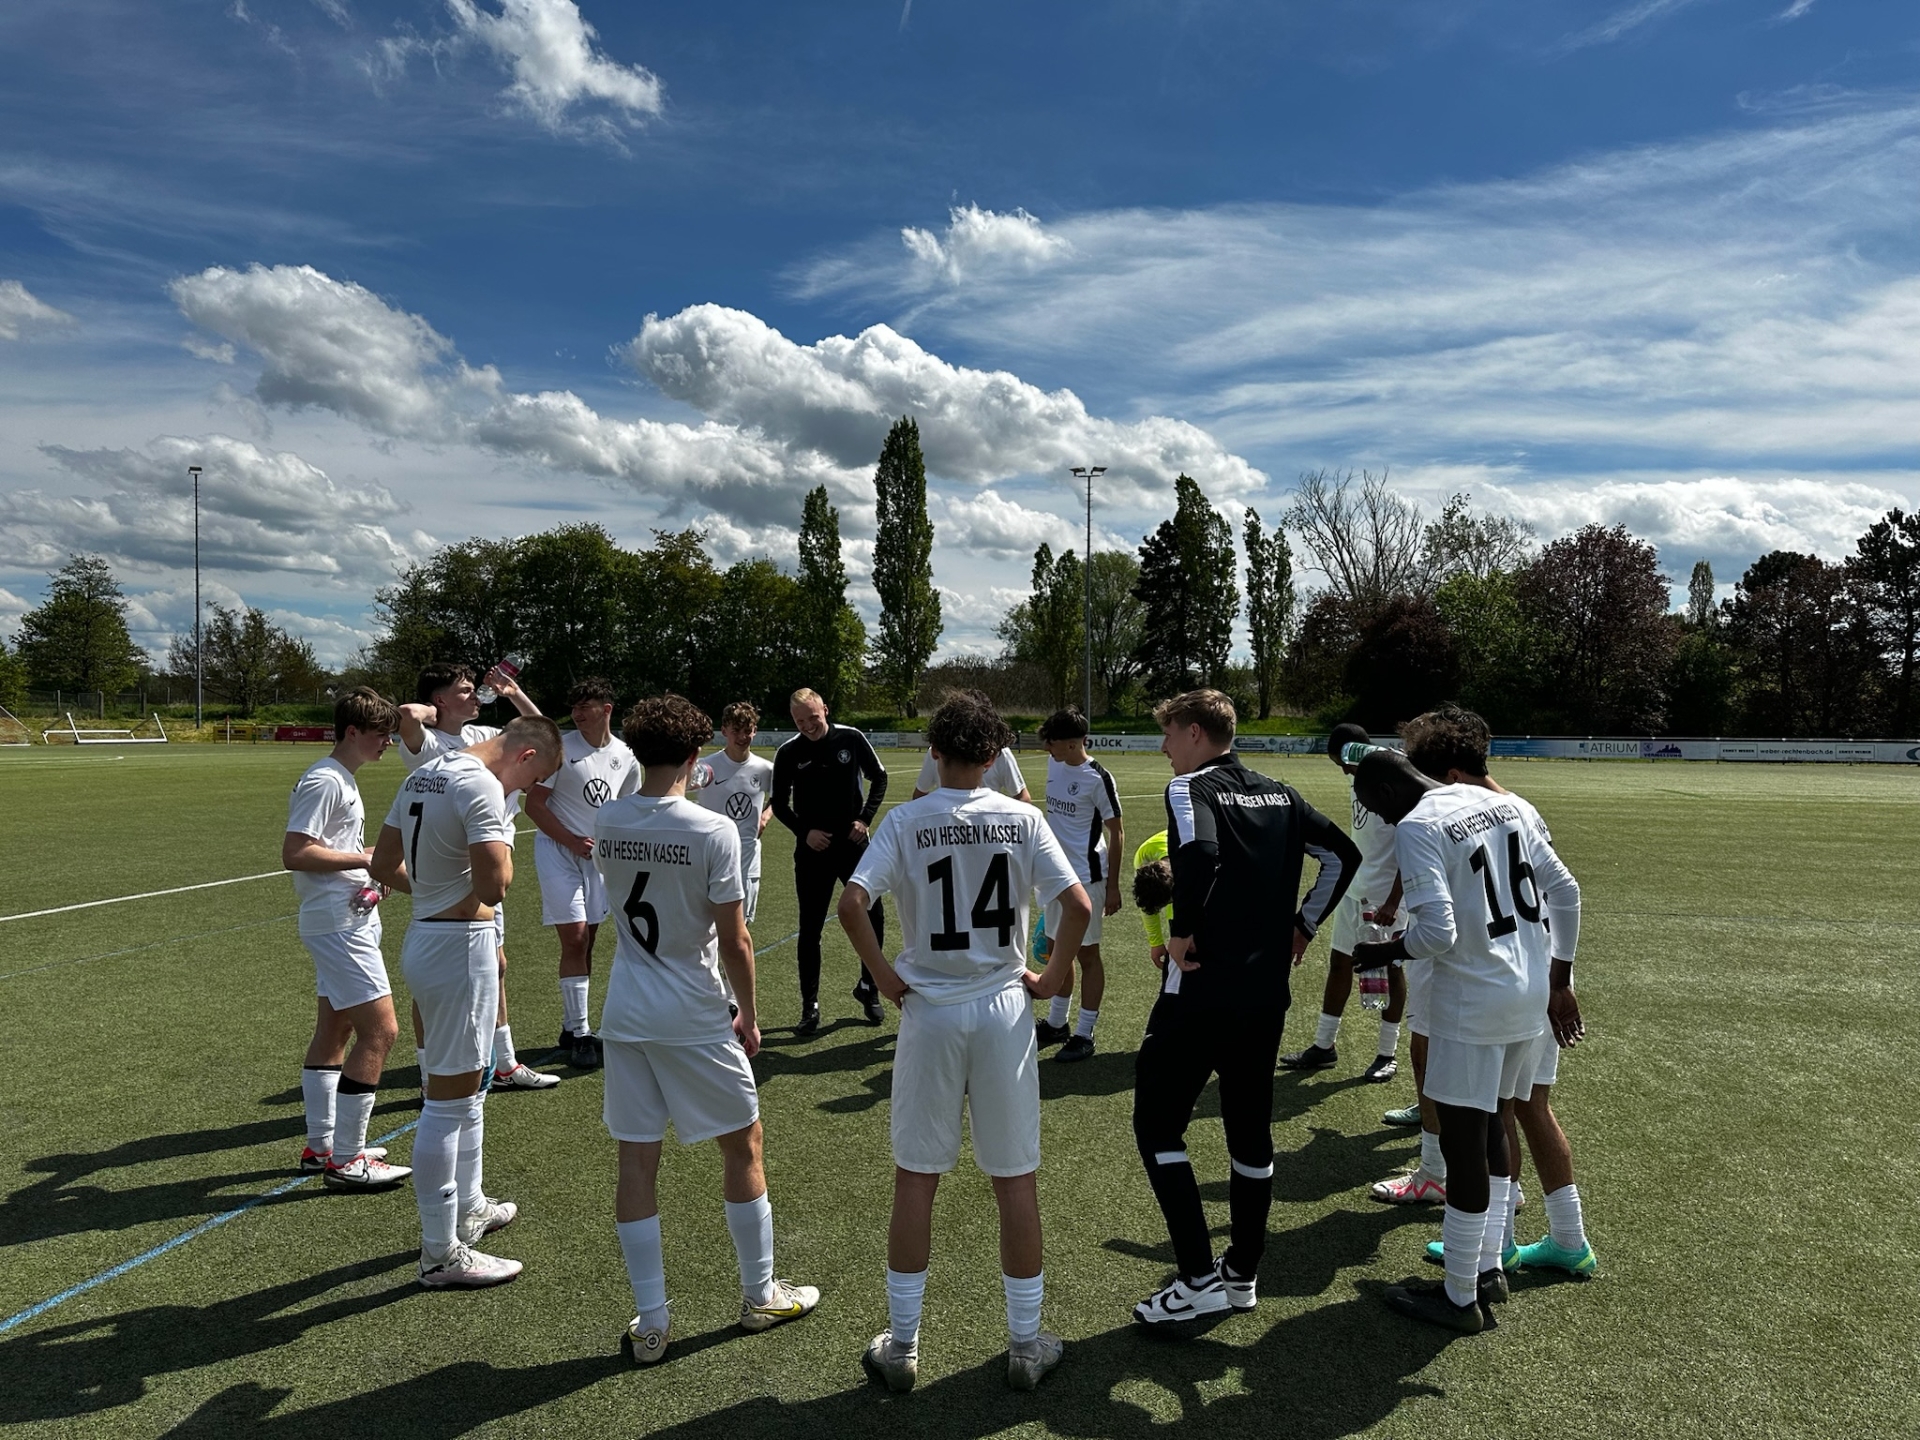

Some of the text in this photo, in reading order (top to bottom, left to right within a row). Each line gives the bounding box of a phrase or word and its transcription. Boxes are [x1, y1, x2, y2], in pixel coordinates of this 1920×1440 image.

[1590, 742, 1638, 754] ATRIUM
[916, 824, 1023, 850] KSV HESSEN KASSEL
[1444, 820, 1469, 845] KSV
[614, 840, 652, 862] HESSEN
[653, 843, 692, 866] KASSEL
[1469, 830, 1540, 940] 16
[623, 871, 659, 955] 6
[927, 852, 1016, 951] 14
